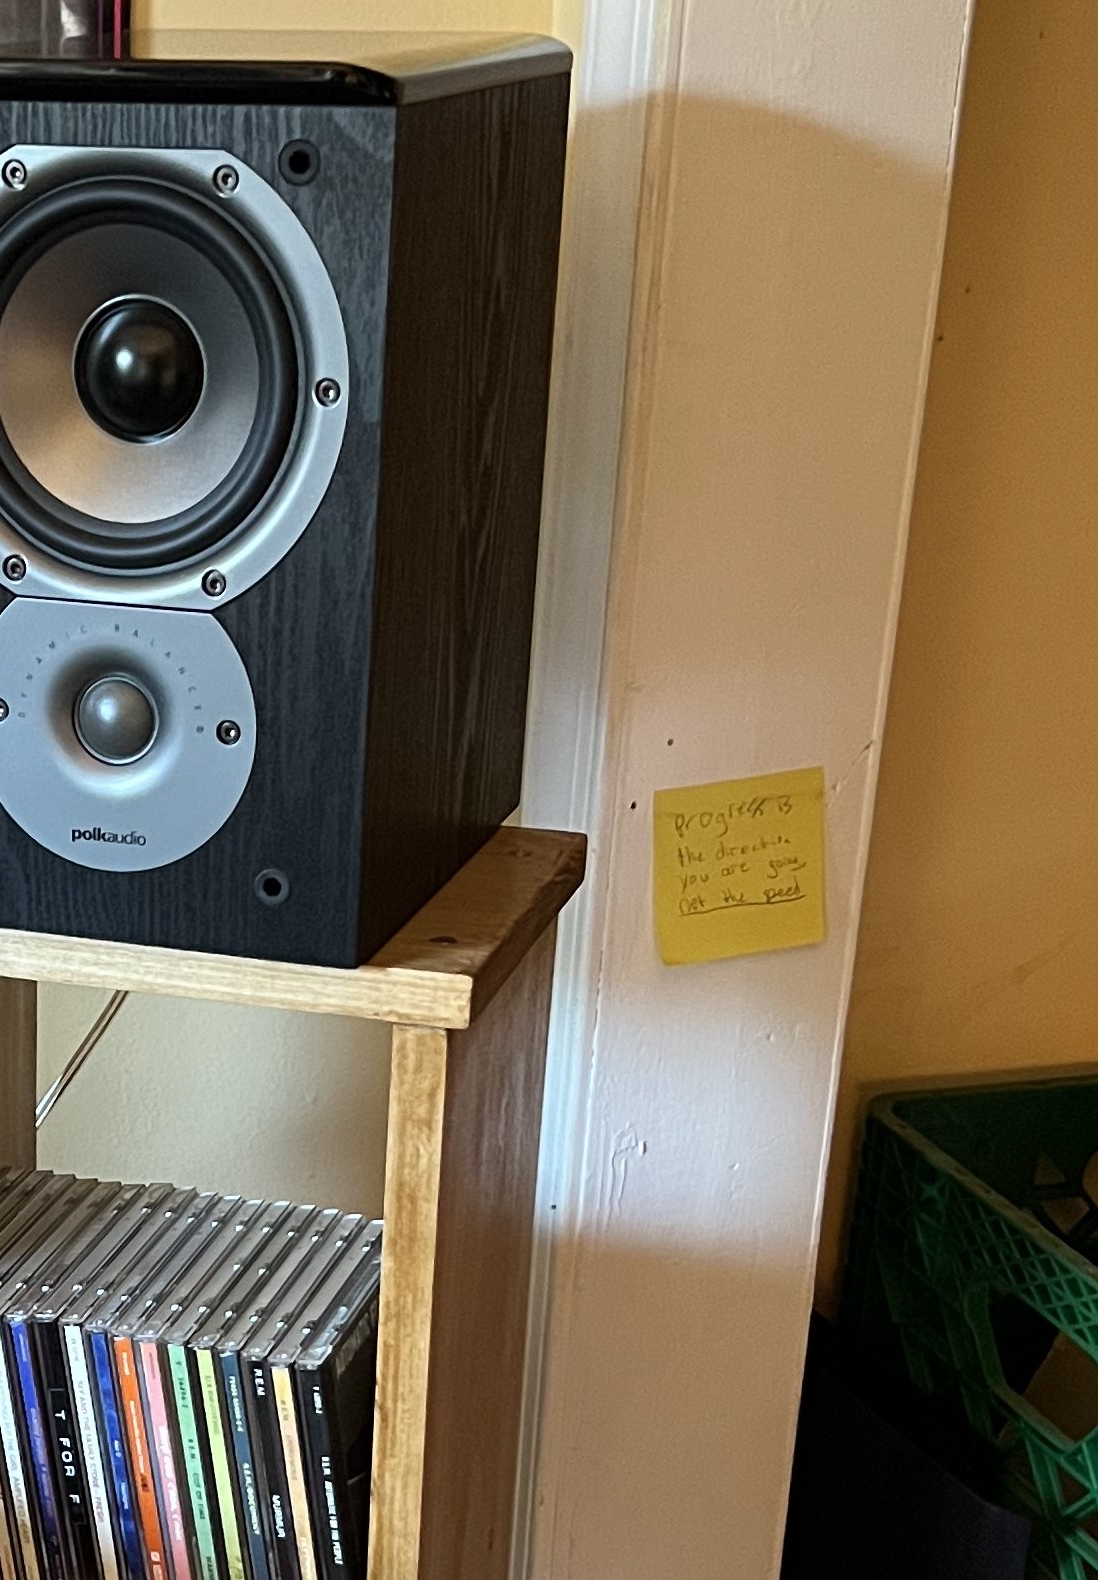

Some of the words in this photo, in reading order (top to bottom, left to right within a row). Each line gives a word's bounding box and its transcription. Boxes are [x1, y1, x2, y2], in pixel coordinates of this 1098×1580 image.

[71, 827, 147, 847] polkaudio
[55, 1409, 66, 1420] T
[59, 1437, 76, 1478] FOR
[69, 1494, 80, 1504] F
